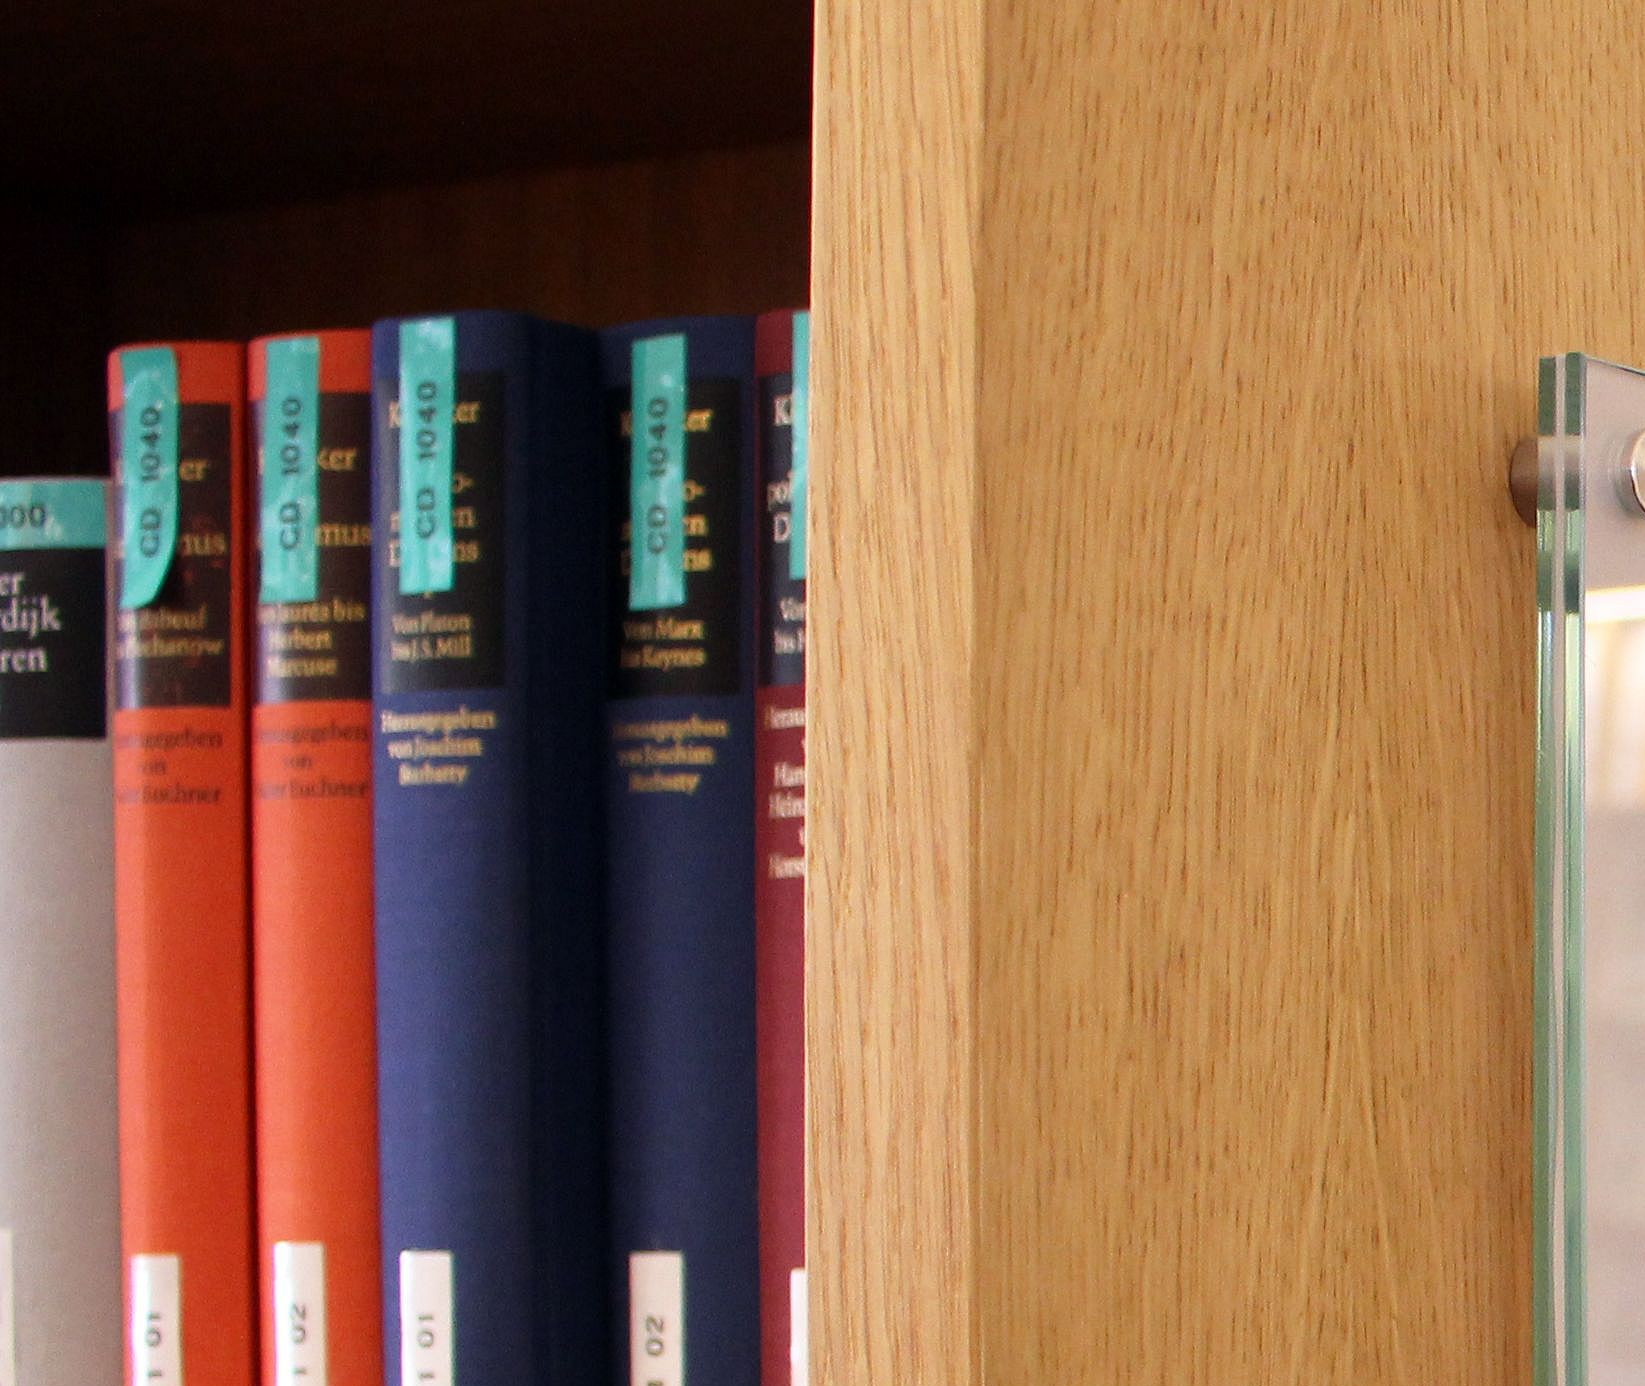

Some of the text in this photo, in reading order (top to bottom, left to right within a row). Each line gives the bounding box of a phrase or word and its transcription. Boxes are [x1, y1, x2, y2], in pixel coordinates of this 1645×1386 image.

[140, 406, 162, 558] CD 1040
[280, 396, 301, 550] CD 1040
[415, 380, 437, 540] CD 1040
[648, 398, 668, 553] CD 1040
[146, 1311, 162, 1348] 01
[290, 1303, 307, 1345] 02
[417, 1312, 434, 1349] 01
[646, 1315, 664, 1357] 02
